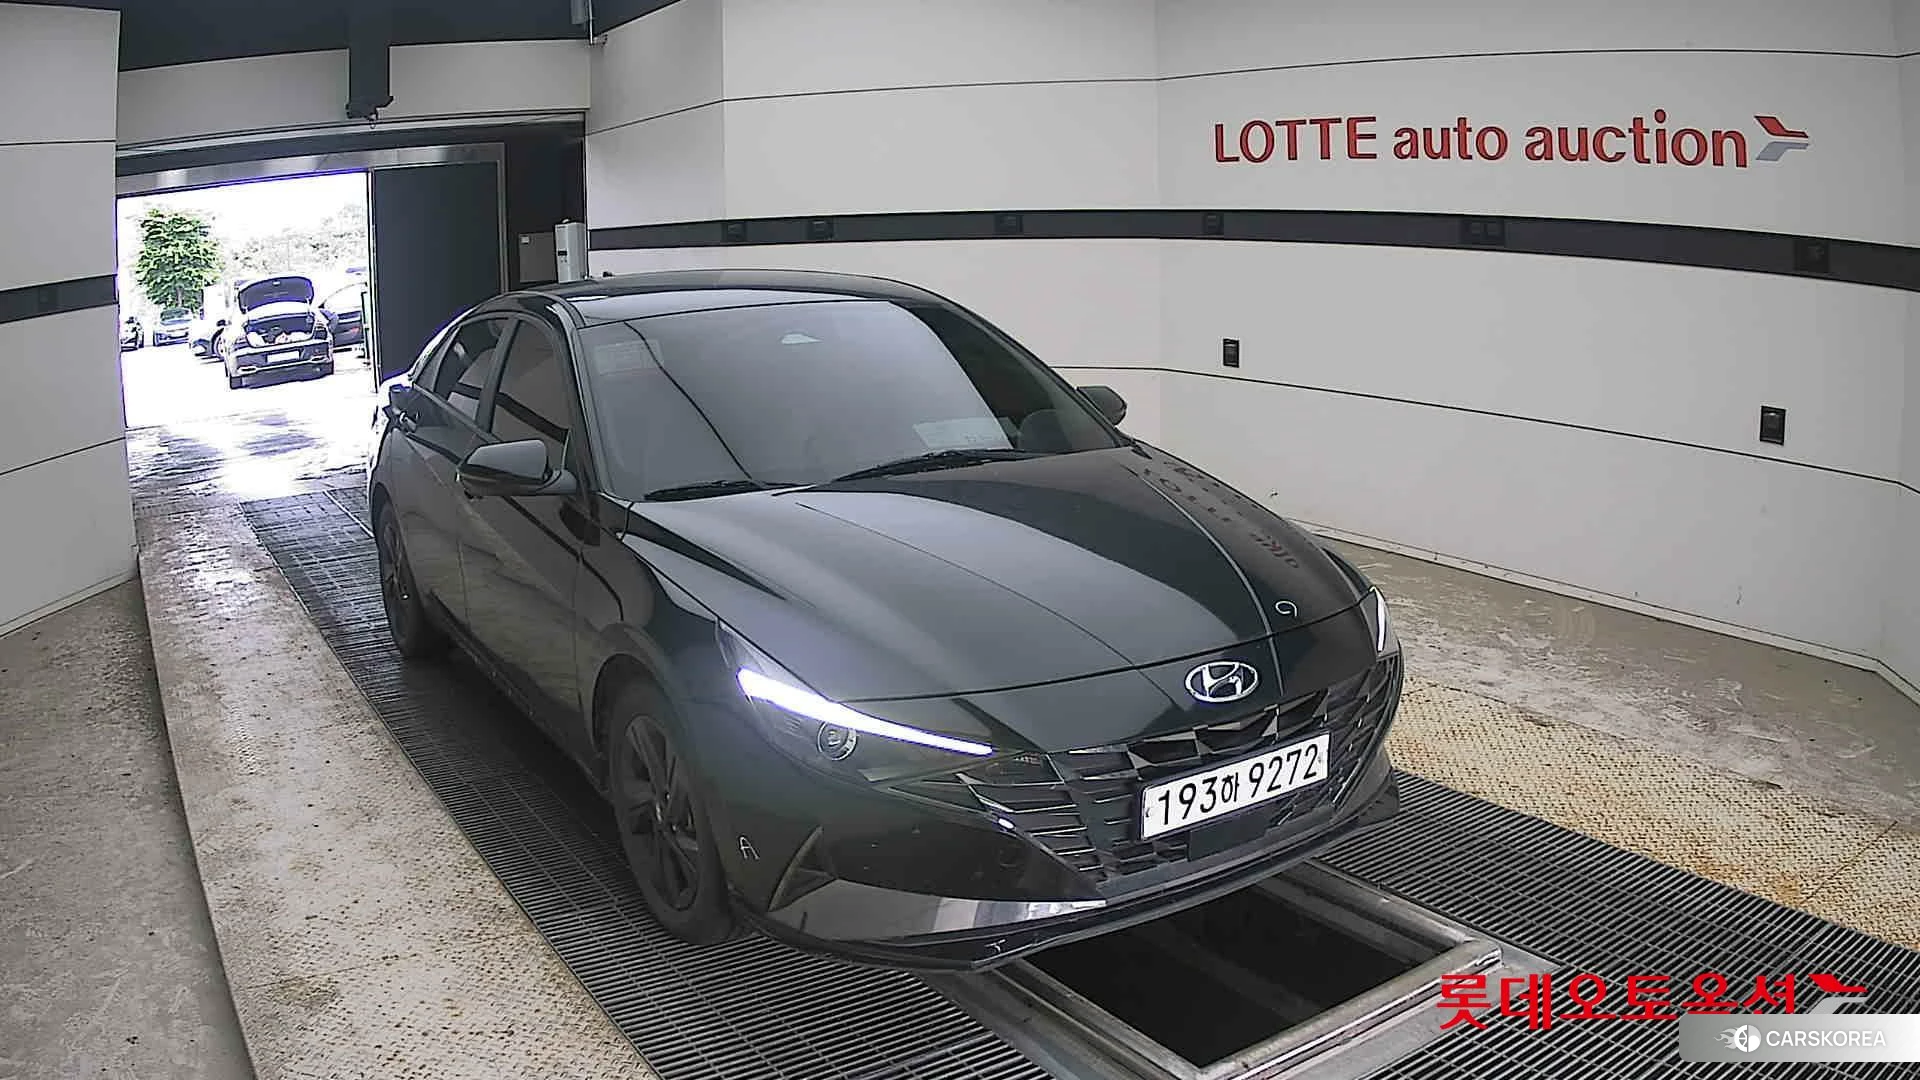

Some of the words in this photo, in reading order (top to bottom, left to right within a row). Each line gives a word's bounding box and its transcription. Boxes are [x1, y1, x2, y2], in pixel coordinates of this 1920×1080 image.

[1214, 115, 1378, 163] LOTTE
[1393, 116, 1509, 161] auto
[1524, 108, 1748, 169] auction
[1158, 772, 1240, 827] 193하
[1248, 742, 1319, 799] 9272
